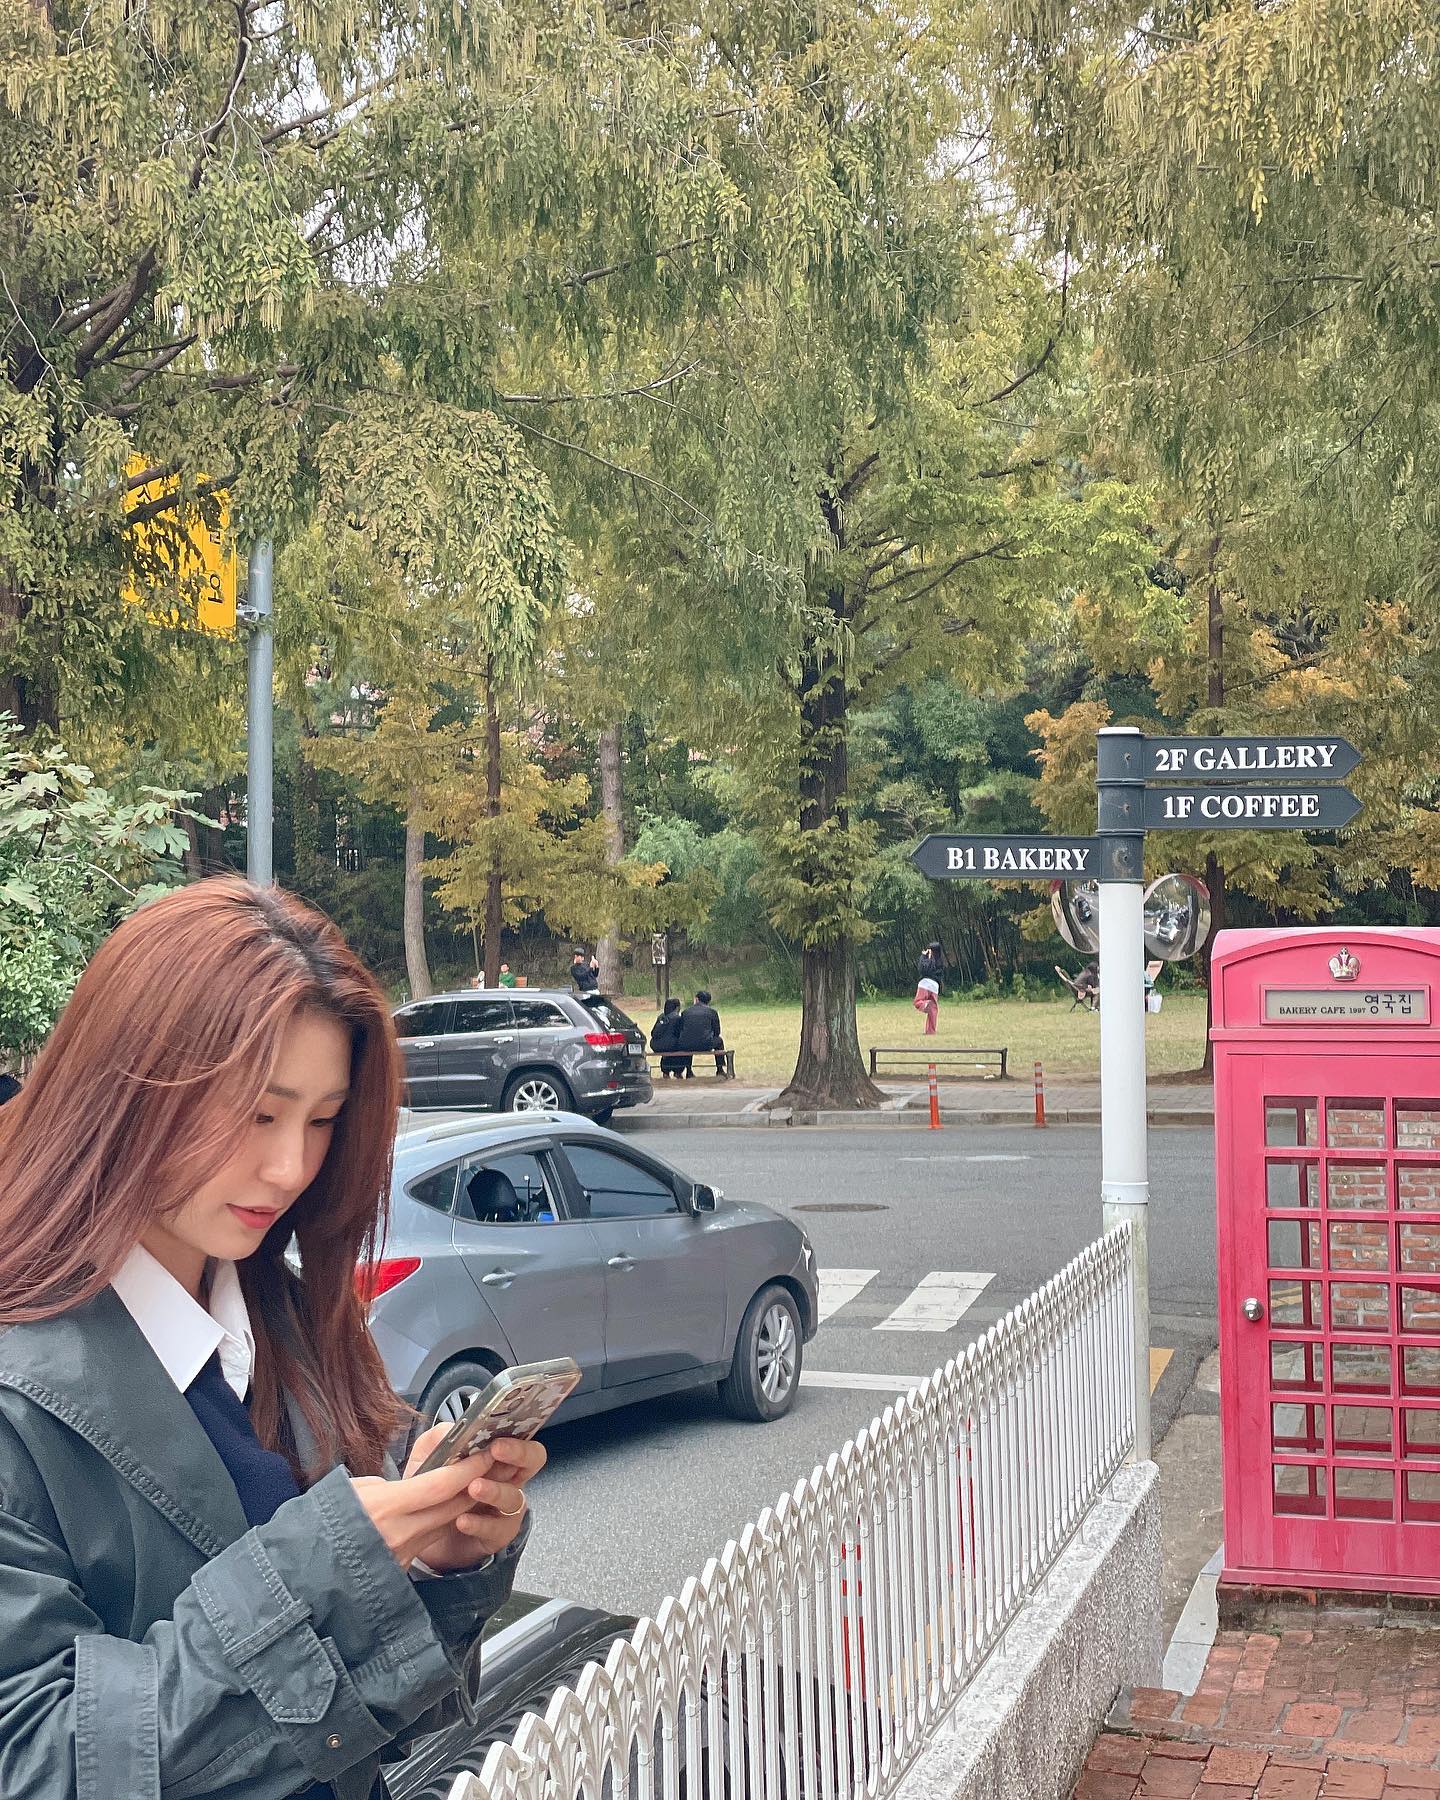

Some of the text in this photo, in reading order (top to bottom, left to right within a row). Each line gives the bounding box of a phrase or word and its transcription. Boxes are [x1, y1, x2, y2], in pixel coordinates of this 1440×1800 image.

[1155, 744, 1338, 771] 2F GALLERY
[1163, 794, 1321, 818] 1F COFFEE
[946, 847, 1090, 871] B1 BAKERY
[1279, 1006, 1318, 1015] BAKERY
[1320, 1006, 1346, 1015] CAFE
[1364, 993, 1412, 1015] 영국집
